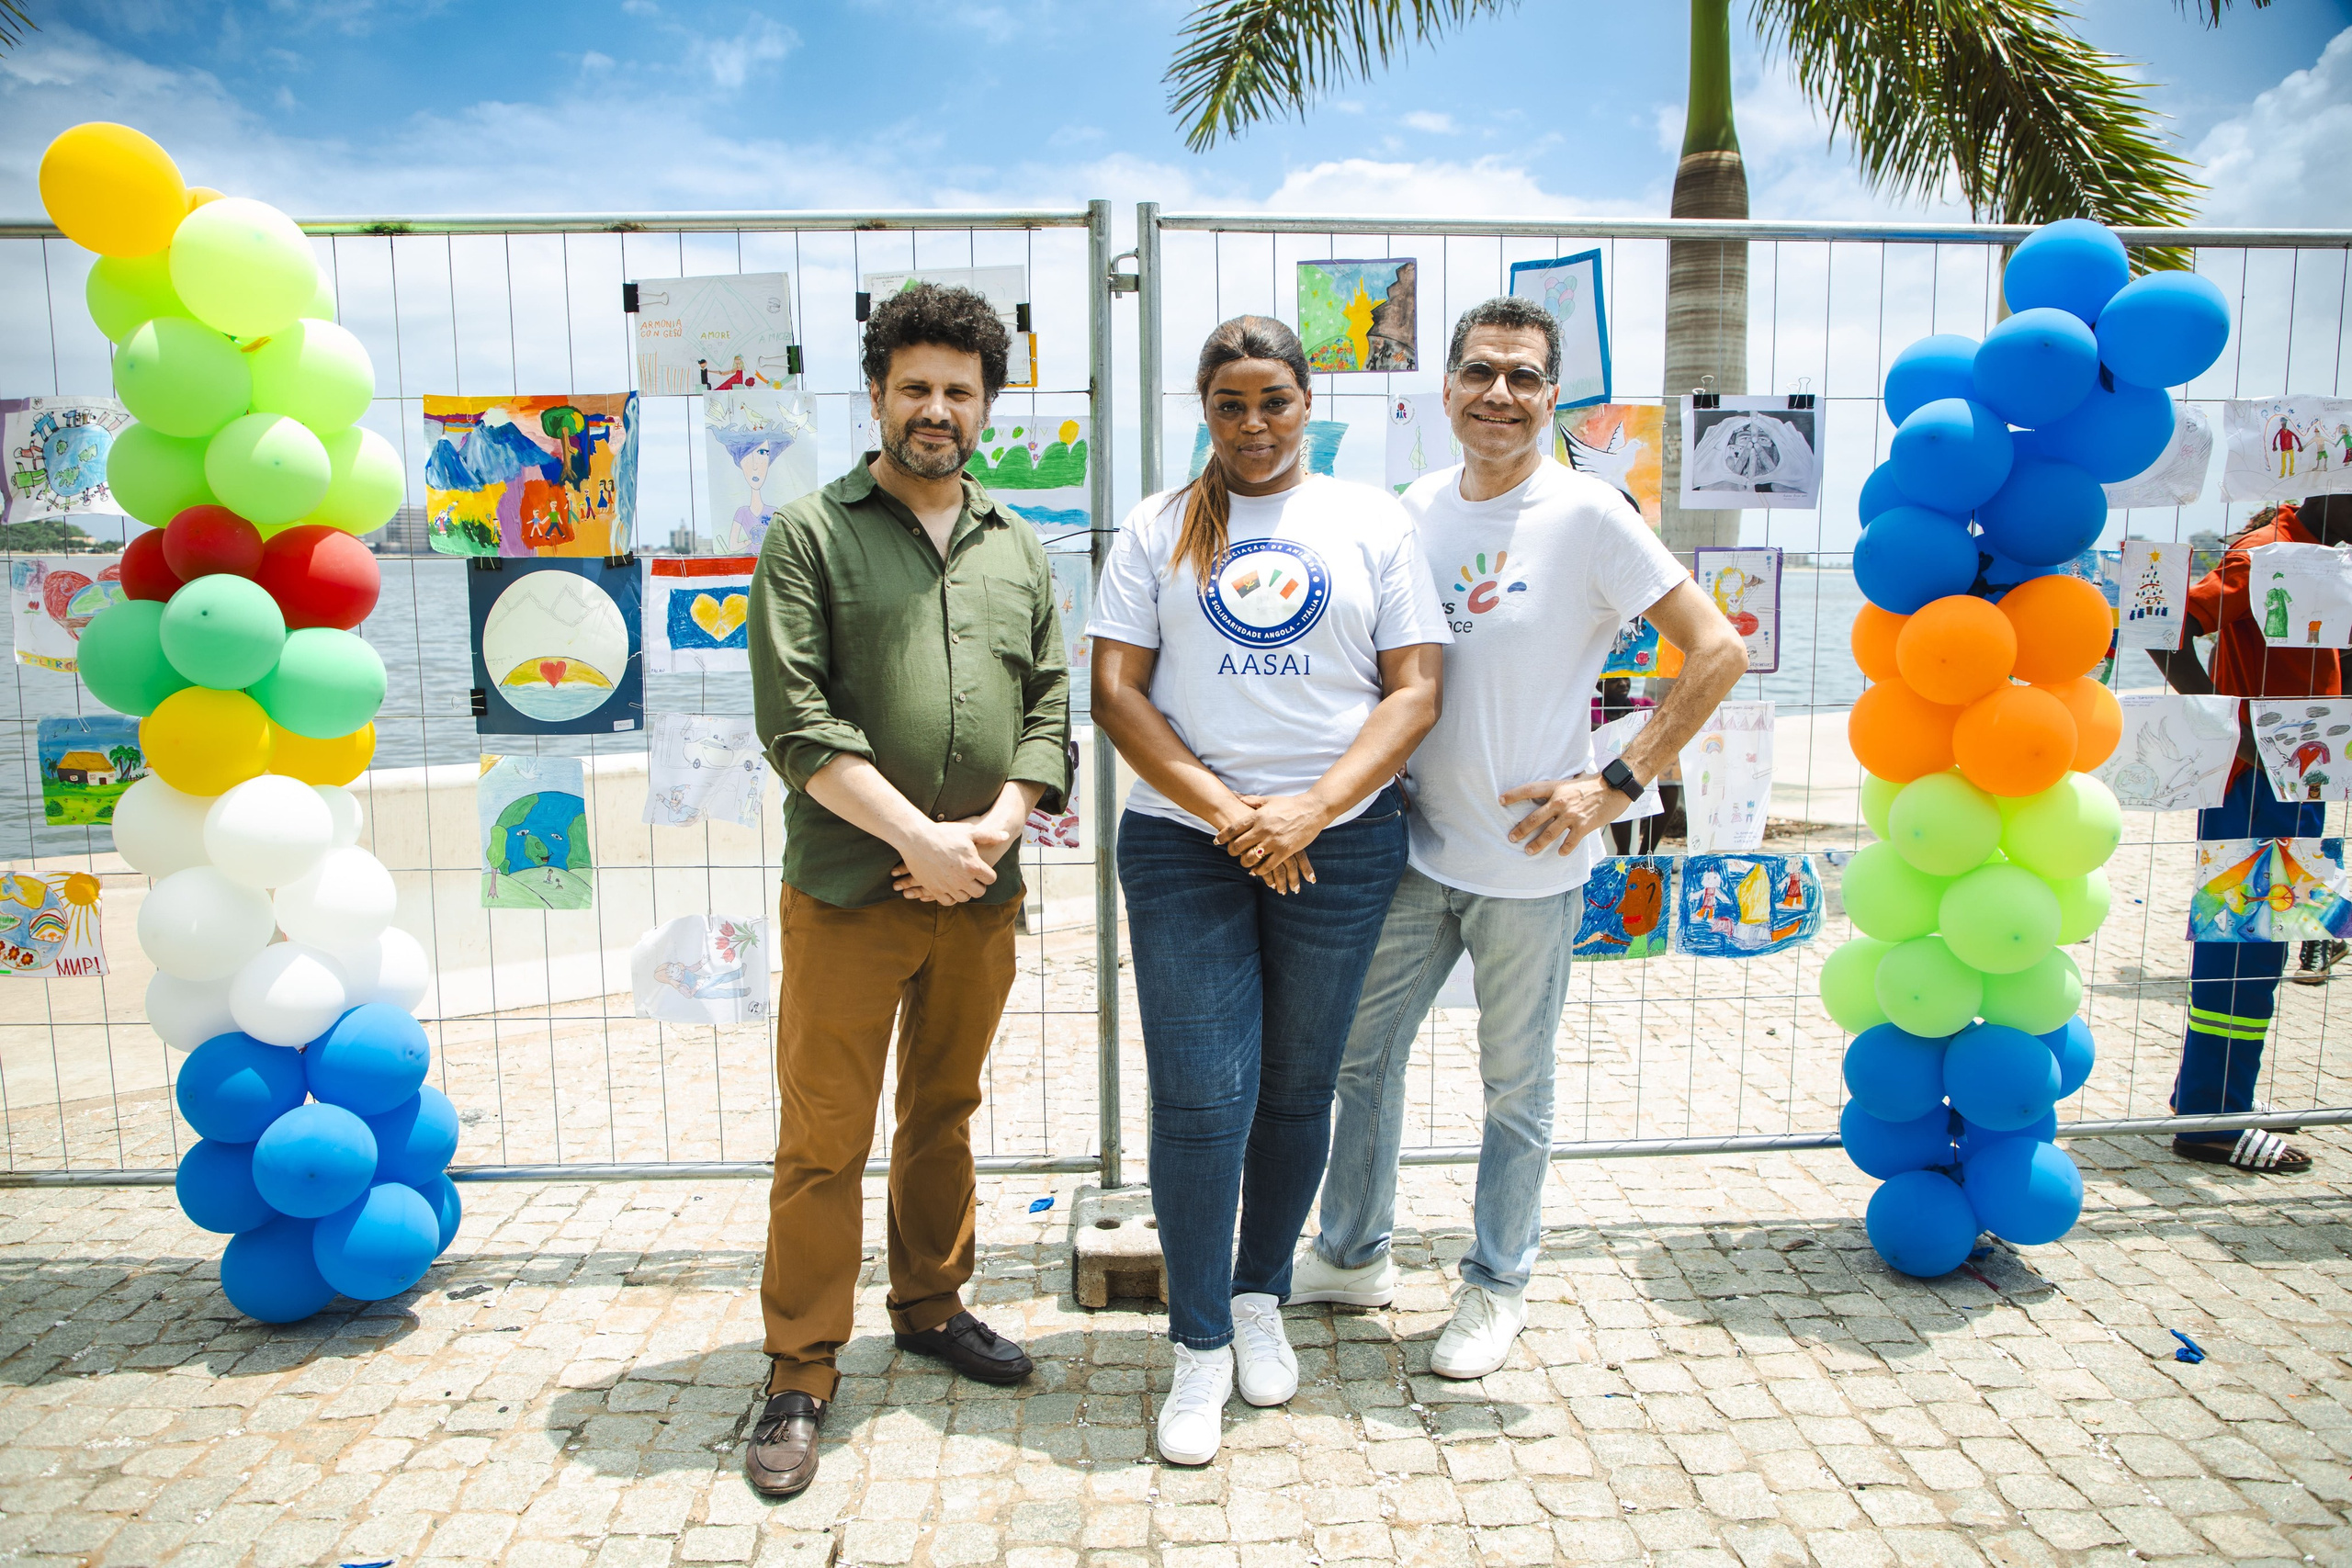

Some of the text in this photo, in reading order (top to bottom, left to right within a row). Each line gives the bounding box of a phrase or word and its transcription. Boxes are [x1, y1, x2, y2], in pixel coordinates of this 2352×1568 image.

[640, 319, 682, 330] ARMONIA
[700, 331, 731, 340] AMORE
[1212, 600, 1261, 638] SOLIDARIEDADE
[1264, 626, 1295, 638] ANGOLA
[1217, 653, 1310, 675] AASAI
[56, 956, 101, 976] МИР!
